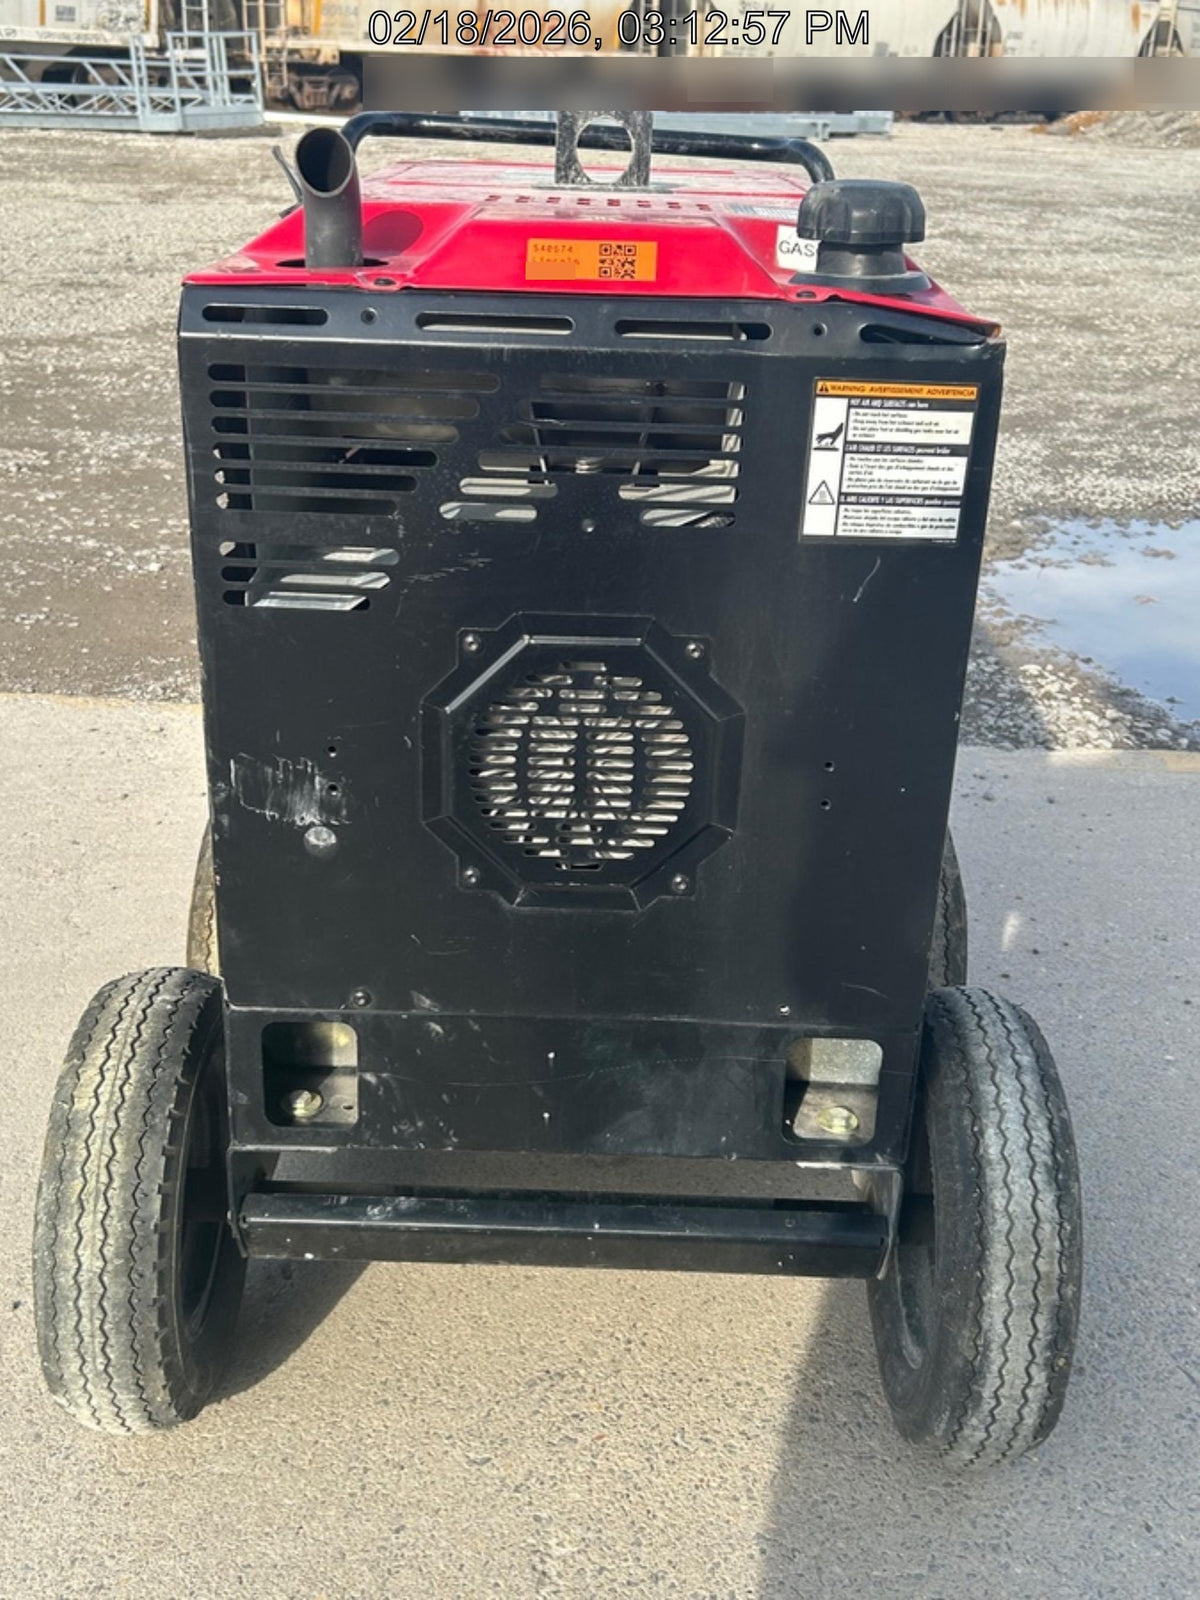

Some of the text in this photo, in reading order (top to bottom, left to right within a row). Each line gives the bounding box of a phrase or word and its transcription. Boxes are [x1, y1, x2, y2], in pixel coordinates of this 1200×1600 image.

[778, 239, 816, 258] GAS
[830, 384, 975, 397] WARNING AVERTISSEMENT ADVERTENCIA
